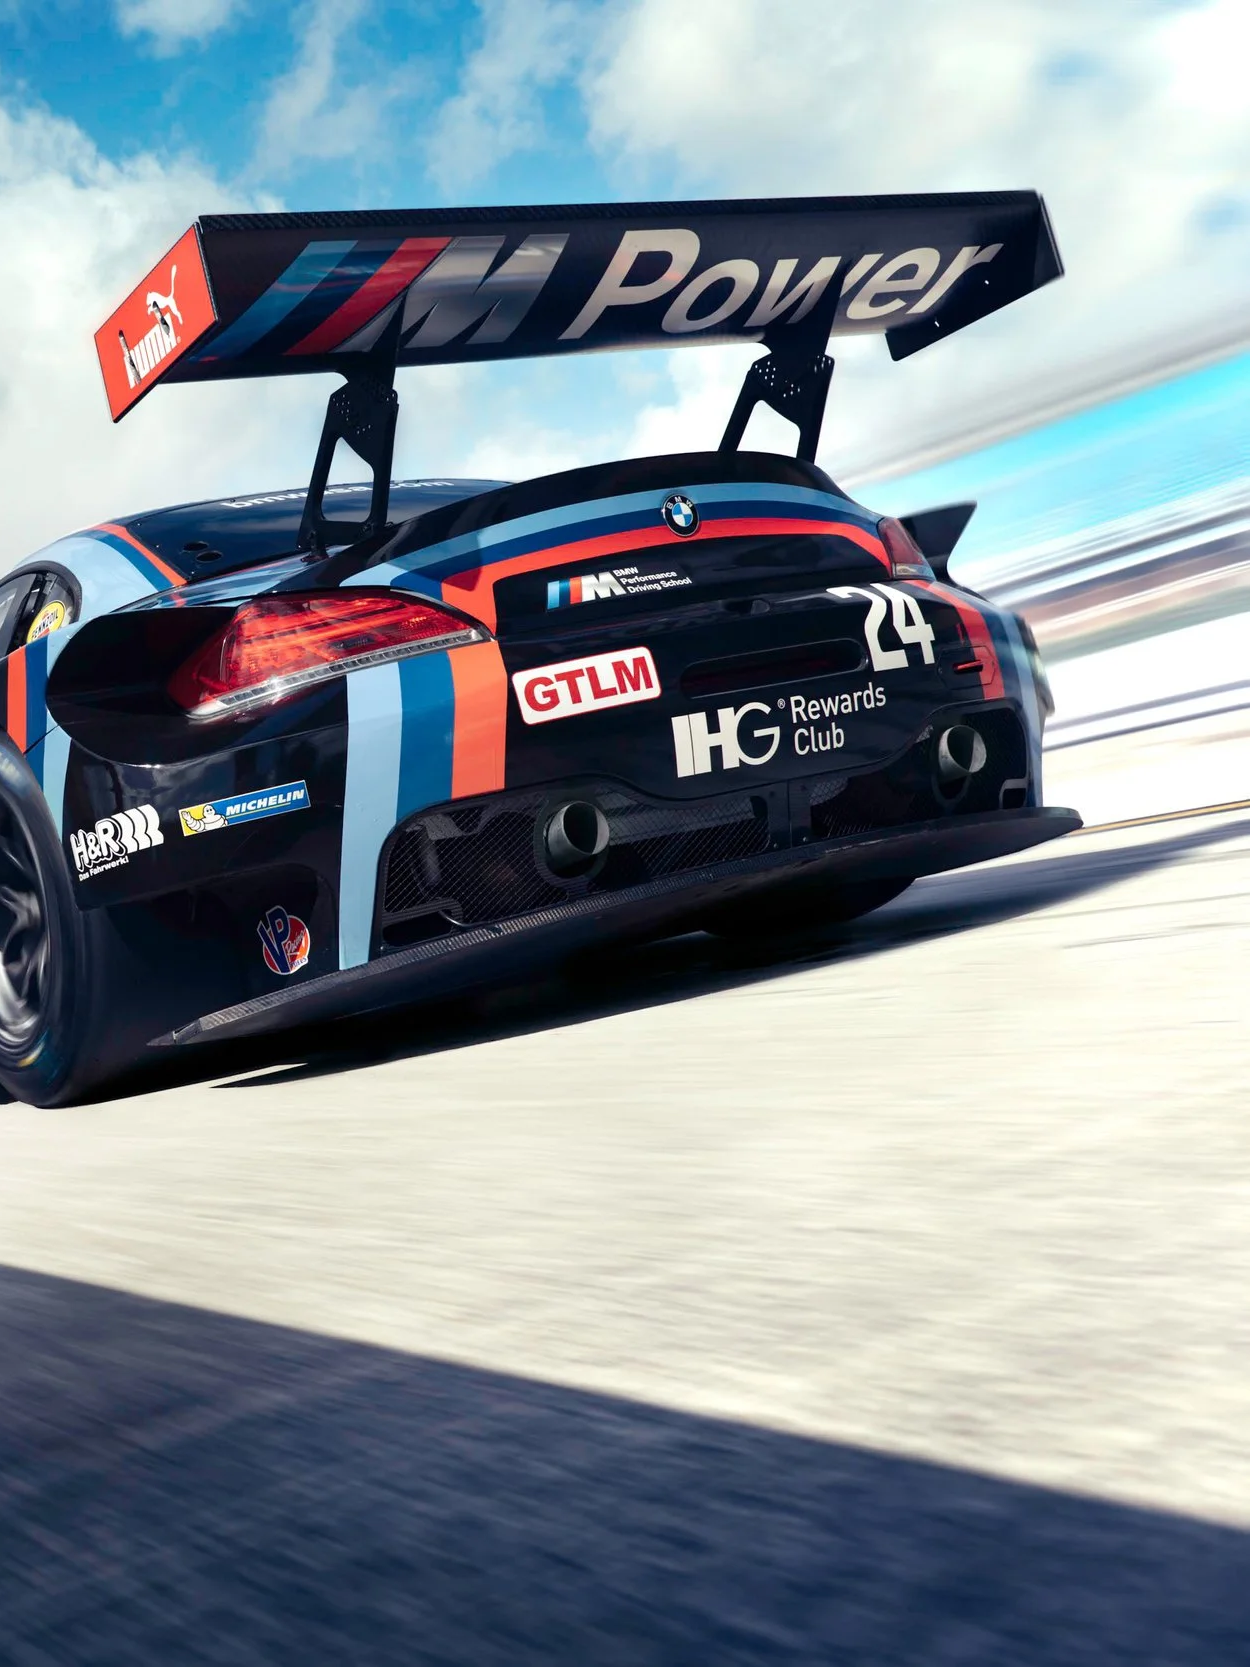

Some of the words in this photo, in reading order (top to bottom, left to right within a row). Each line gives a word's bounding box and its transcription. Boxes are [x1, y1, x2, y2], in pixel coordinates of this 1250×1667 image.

[557, 228, 1004, 341] Power
[612, 566, 639, 578] BMW
[619, 570, 678, 586] Performance
[626, 582, 662, 595] Driving
[659, 576, 693, 590] School
[826, 582, 936, 672] 24
[524, 656, 654, 712] GTLM
[790, 682, 887, 724] Rewards
[794, 722, 845, 756] Club
[225, 789, 305, 816] MICHELIN
[70, 814, 134, 872] H&R
[78, 871, 90, 882] Das
[89, 855, 129, 877] Fahrwerk!
[257, 905, 291, 974] VP
